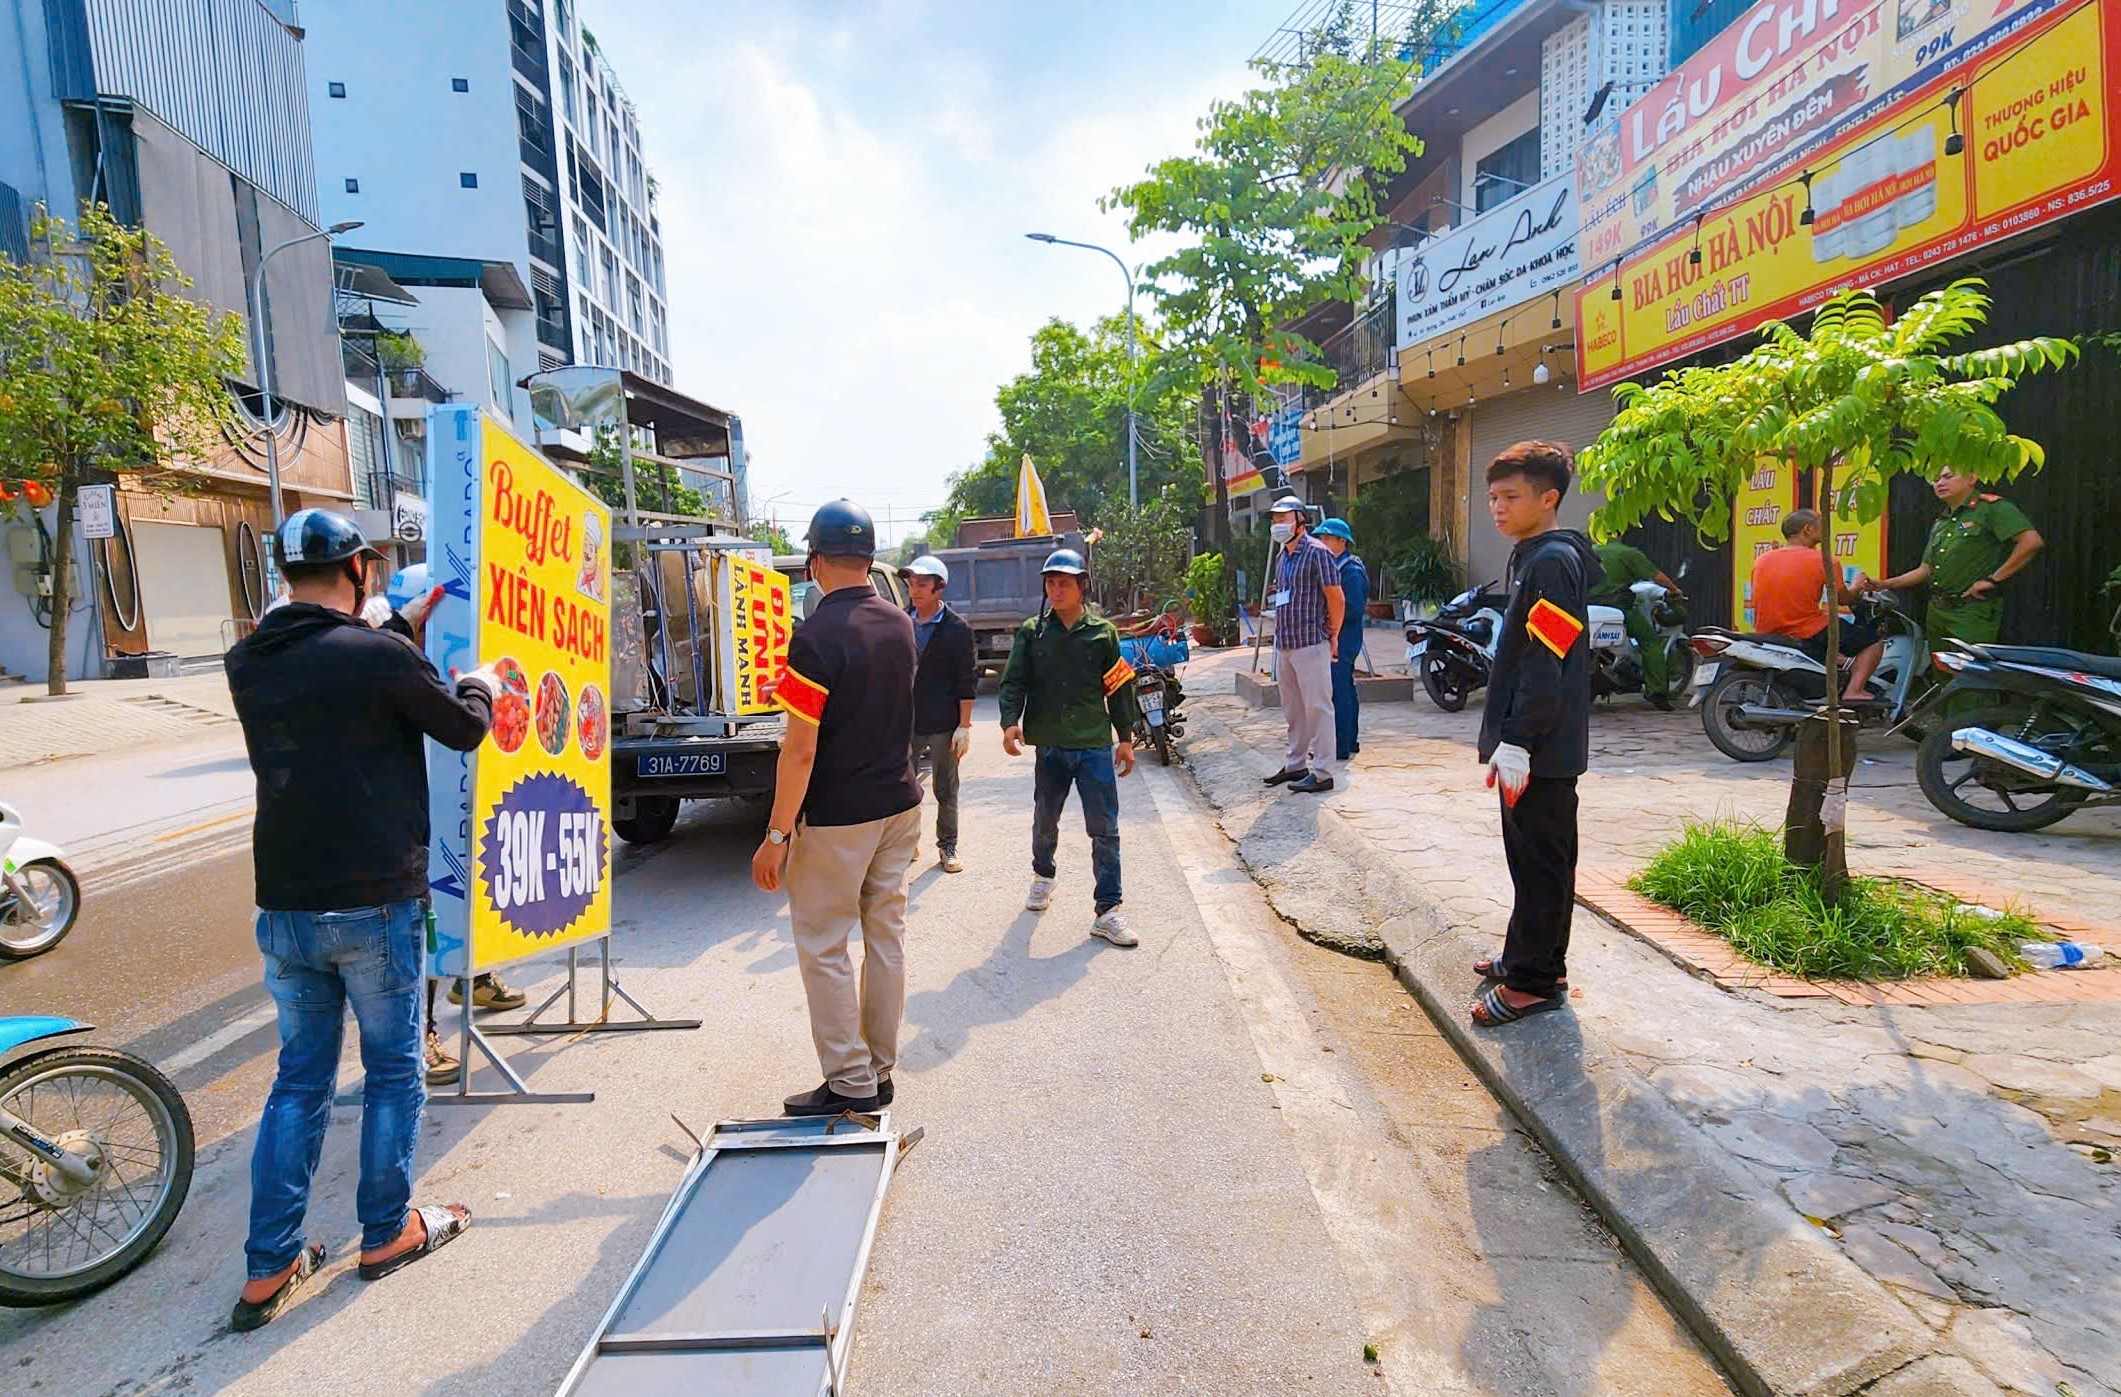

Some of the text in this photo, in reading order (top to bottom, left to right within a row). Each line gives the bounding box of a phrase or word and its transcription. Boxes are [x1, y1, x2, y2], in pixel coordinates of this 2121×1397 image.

[1915, 26, 1955, 67] 99K
[2050, 67, 2086, 98] HIỆU
[1632, 73, 1722, 161] LẨU
[1984, 98, 2090, 162] QUỐC GIA
[1665, 132, 1705, 176] BIA
[1688, 89, 1833, 197] NHẬU XUYÊN ĐÊM
[1438, 237, 1497, 292] Lan
[1500, 188, 1568, 259] Anh
[1589, 221, 1622, 260] 149K
[1640, 217, 1659, 238] 99K
[1799, 291, 1825, 307] HABECO
[1884, 262, 1899, 273] HAT
[1906, 255, 1921, 267] TEL:
[1922, 247, 1941, 260] 0243
[1943, 241, 1957, 252] 728
[1958, 231, 1977, 246] 1476
[1984, 224, 2000, 236] MS:
[2048, 199, 2065, 211] NS:
[2068, 180, 2111, 204] 836.5/25
[1516, 266, 1526, 277] DA
[1530, 254, 1552, 271] KHOA
[1556, 243, 1575, 262] HỌC
[1633, 269, 1664, 312] BIA
[1708, 217, 1743, 275] HÀ
[1746, 193, 1796, 256] NỘI
[1728, 272, 1750, 306] TT
[1587, 330, 1617, 353] HABECO
[490, 460, 572, 566] Buffet
[1745, 500, 1780, 526] CHẤT
[1835, 533, 1859, 555] TT
[487, 562, 546, 642] XIÊN
[552, 595, 604, 665] SẠCH
[733, 564, 751, 706] LÀNH MẠNH
[649, 755, 720, 773] 31A-7769
